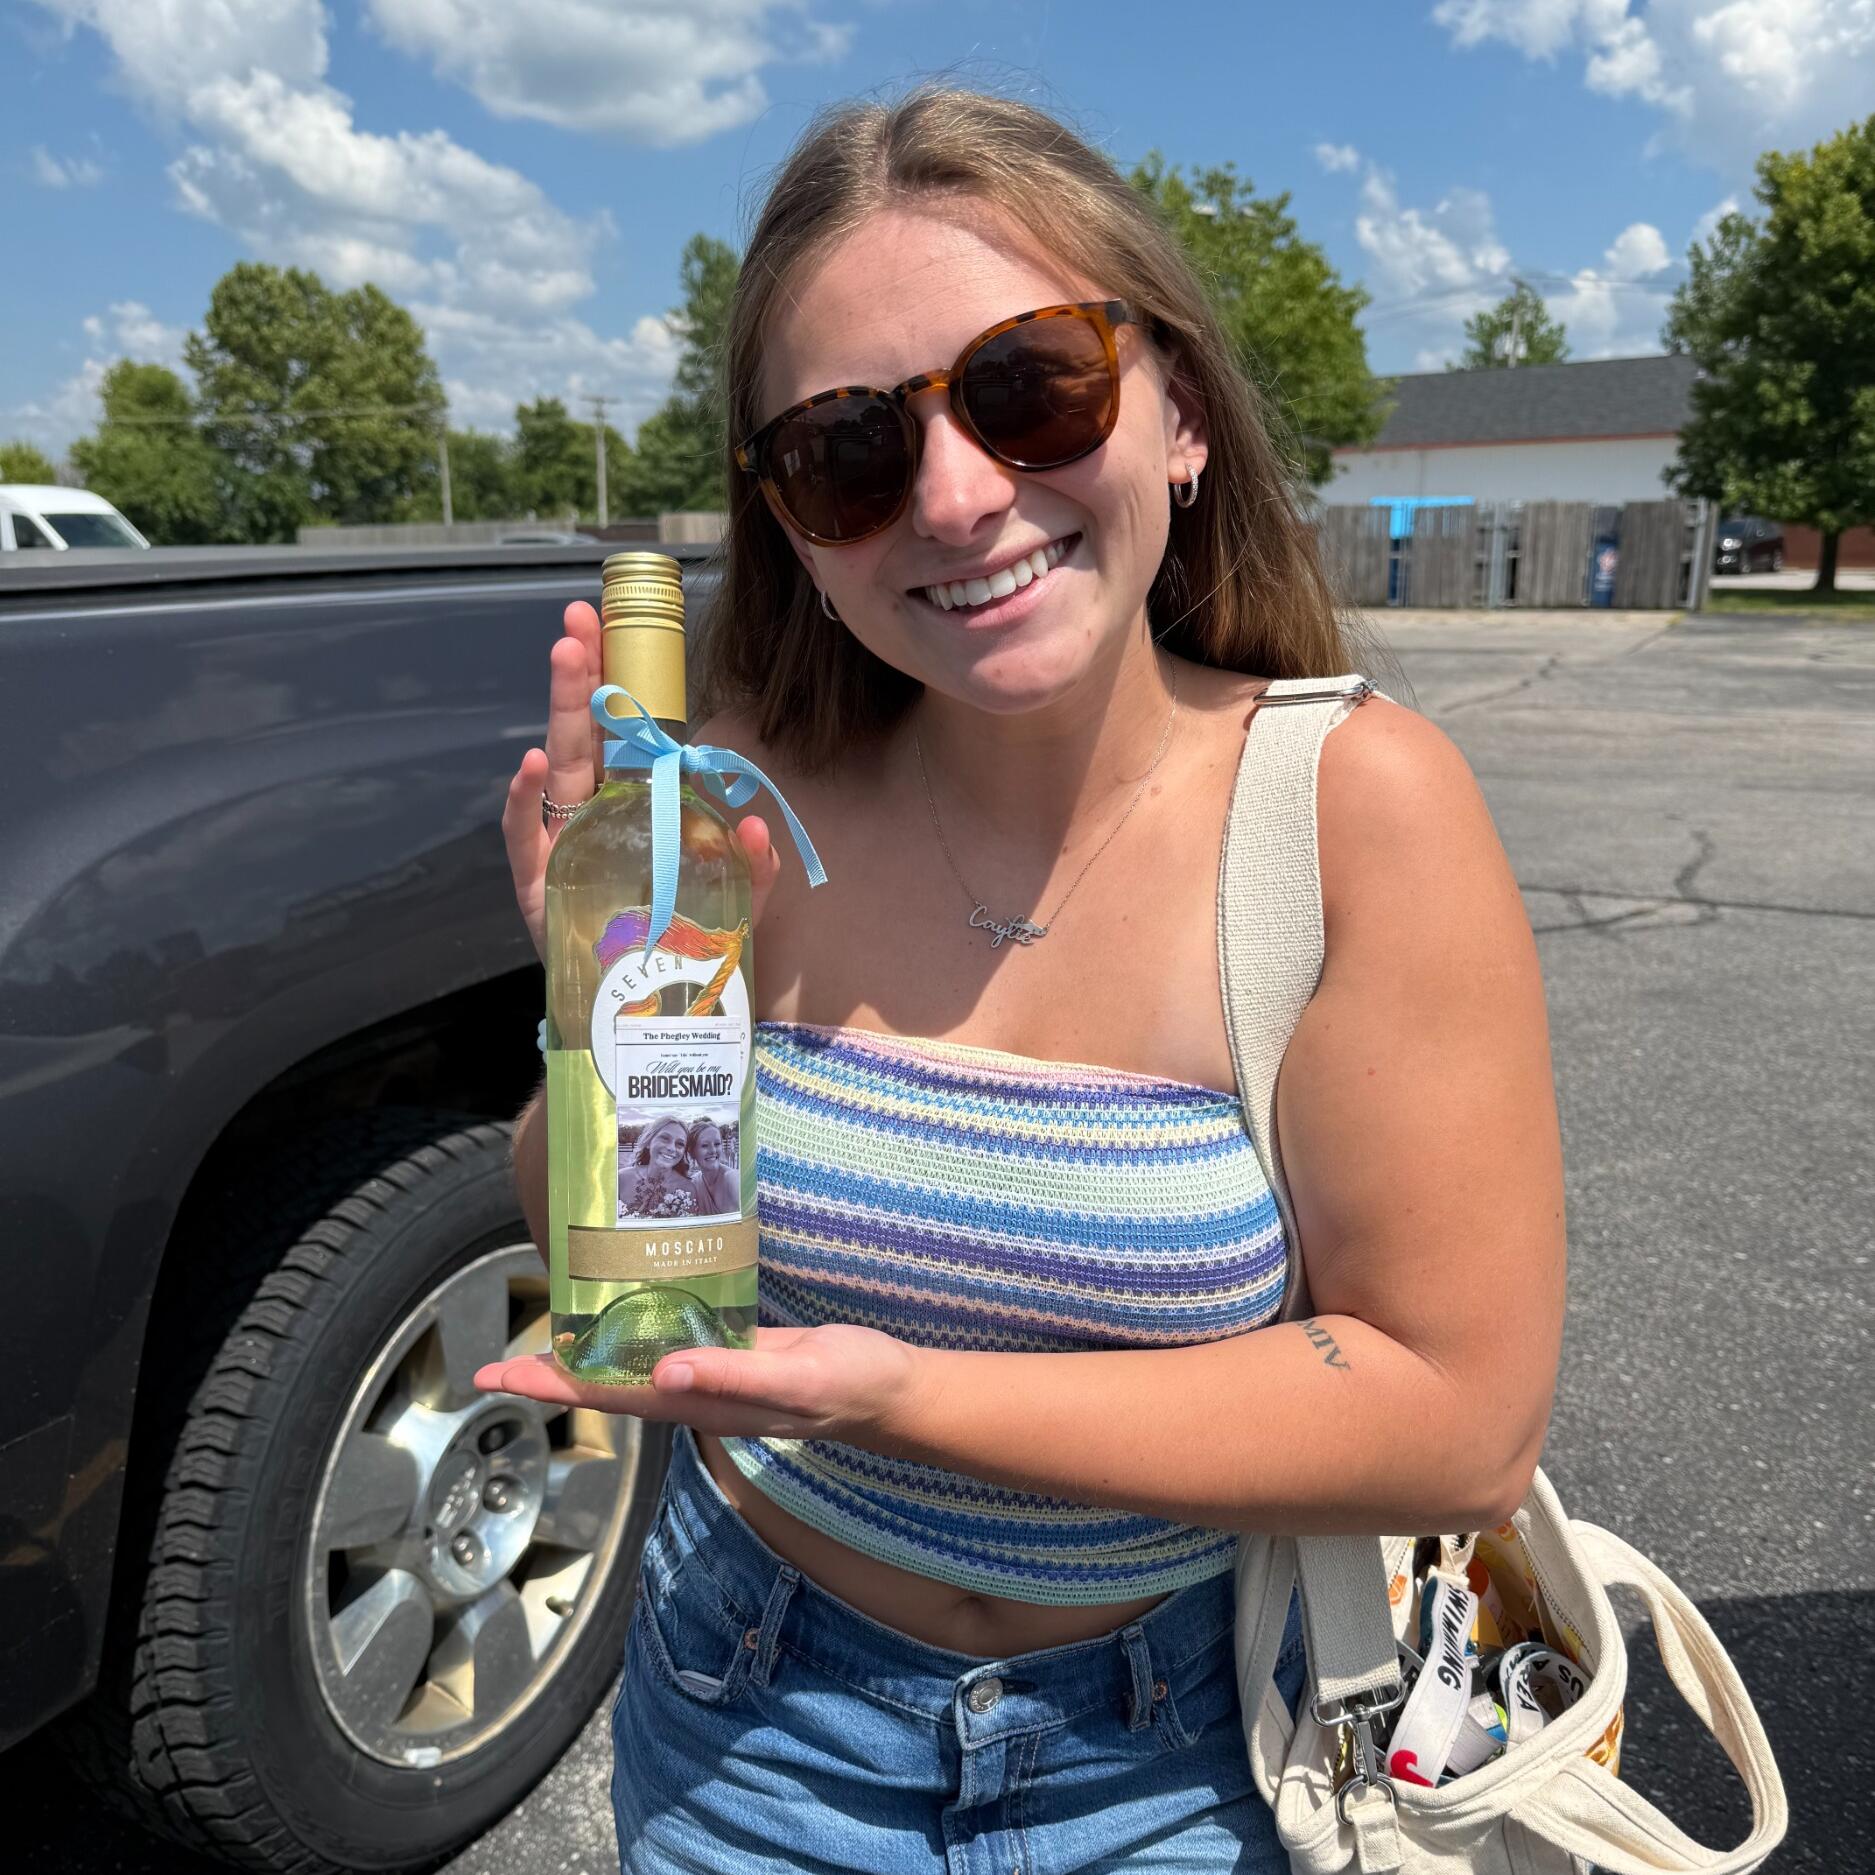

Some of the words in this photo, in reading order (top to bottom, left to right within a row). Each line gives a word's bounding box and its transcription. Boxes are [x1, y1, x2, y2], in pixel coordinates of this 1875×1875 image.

[643, 1032, 659, 1040] The
[660, 1032, 690, 1041] Phegley
[691, 1031, 721, 1040] Wedding
[646, 1060, 681, 1074] Will
[677, 1065, 694, 1076] you
[696, 1061, 707, 1073] be
[707, 1064, 722, 1075] my
[628, 1073, 733, 1099] BRIDESMAID?
[645, 1237, 723, 1257] MOSCATO
[653, 1260, 679, 1268] MADE
[694, 1256, 718, 1265] ITALY
